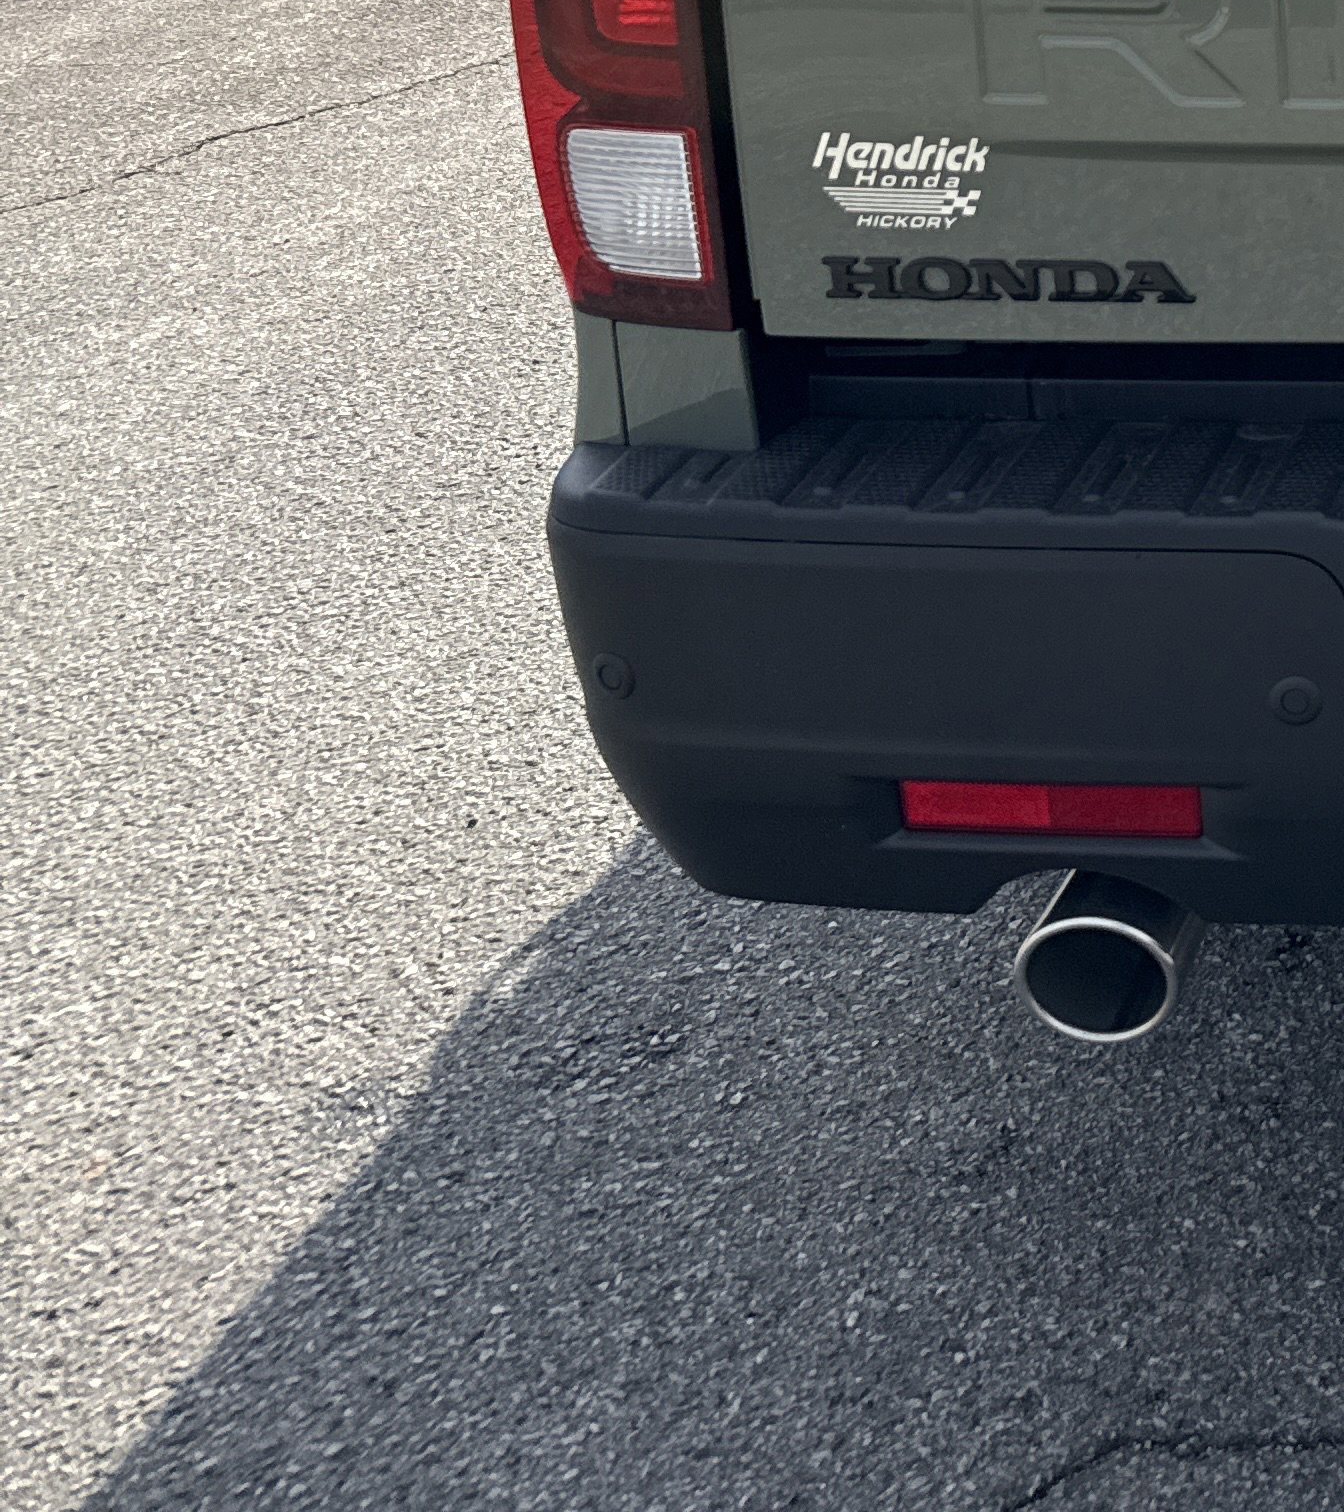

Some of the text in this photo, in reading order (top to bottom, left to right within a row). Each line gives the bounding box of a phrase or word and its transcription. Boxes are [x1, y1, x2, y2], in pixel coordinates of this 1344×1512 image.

[812, 131, 990, 180] Hendrick
[854, 170, 961, 188] Honda
[856, 214, 959, 229] HICKORY
[821, 255, 1197, 304] HONDA
